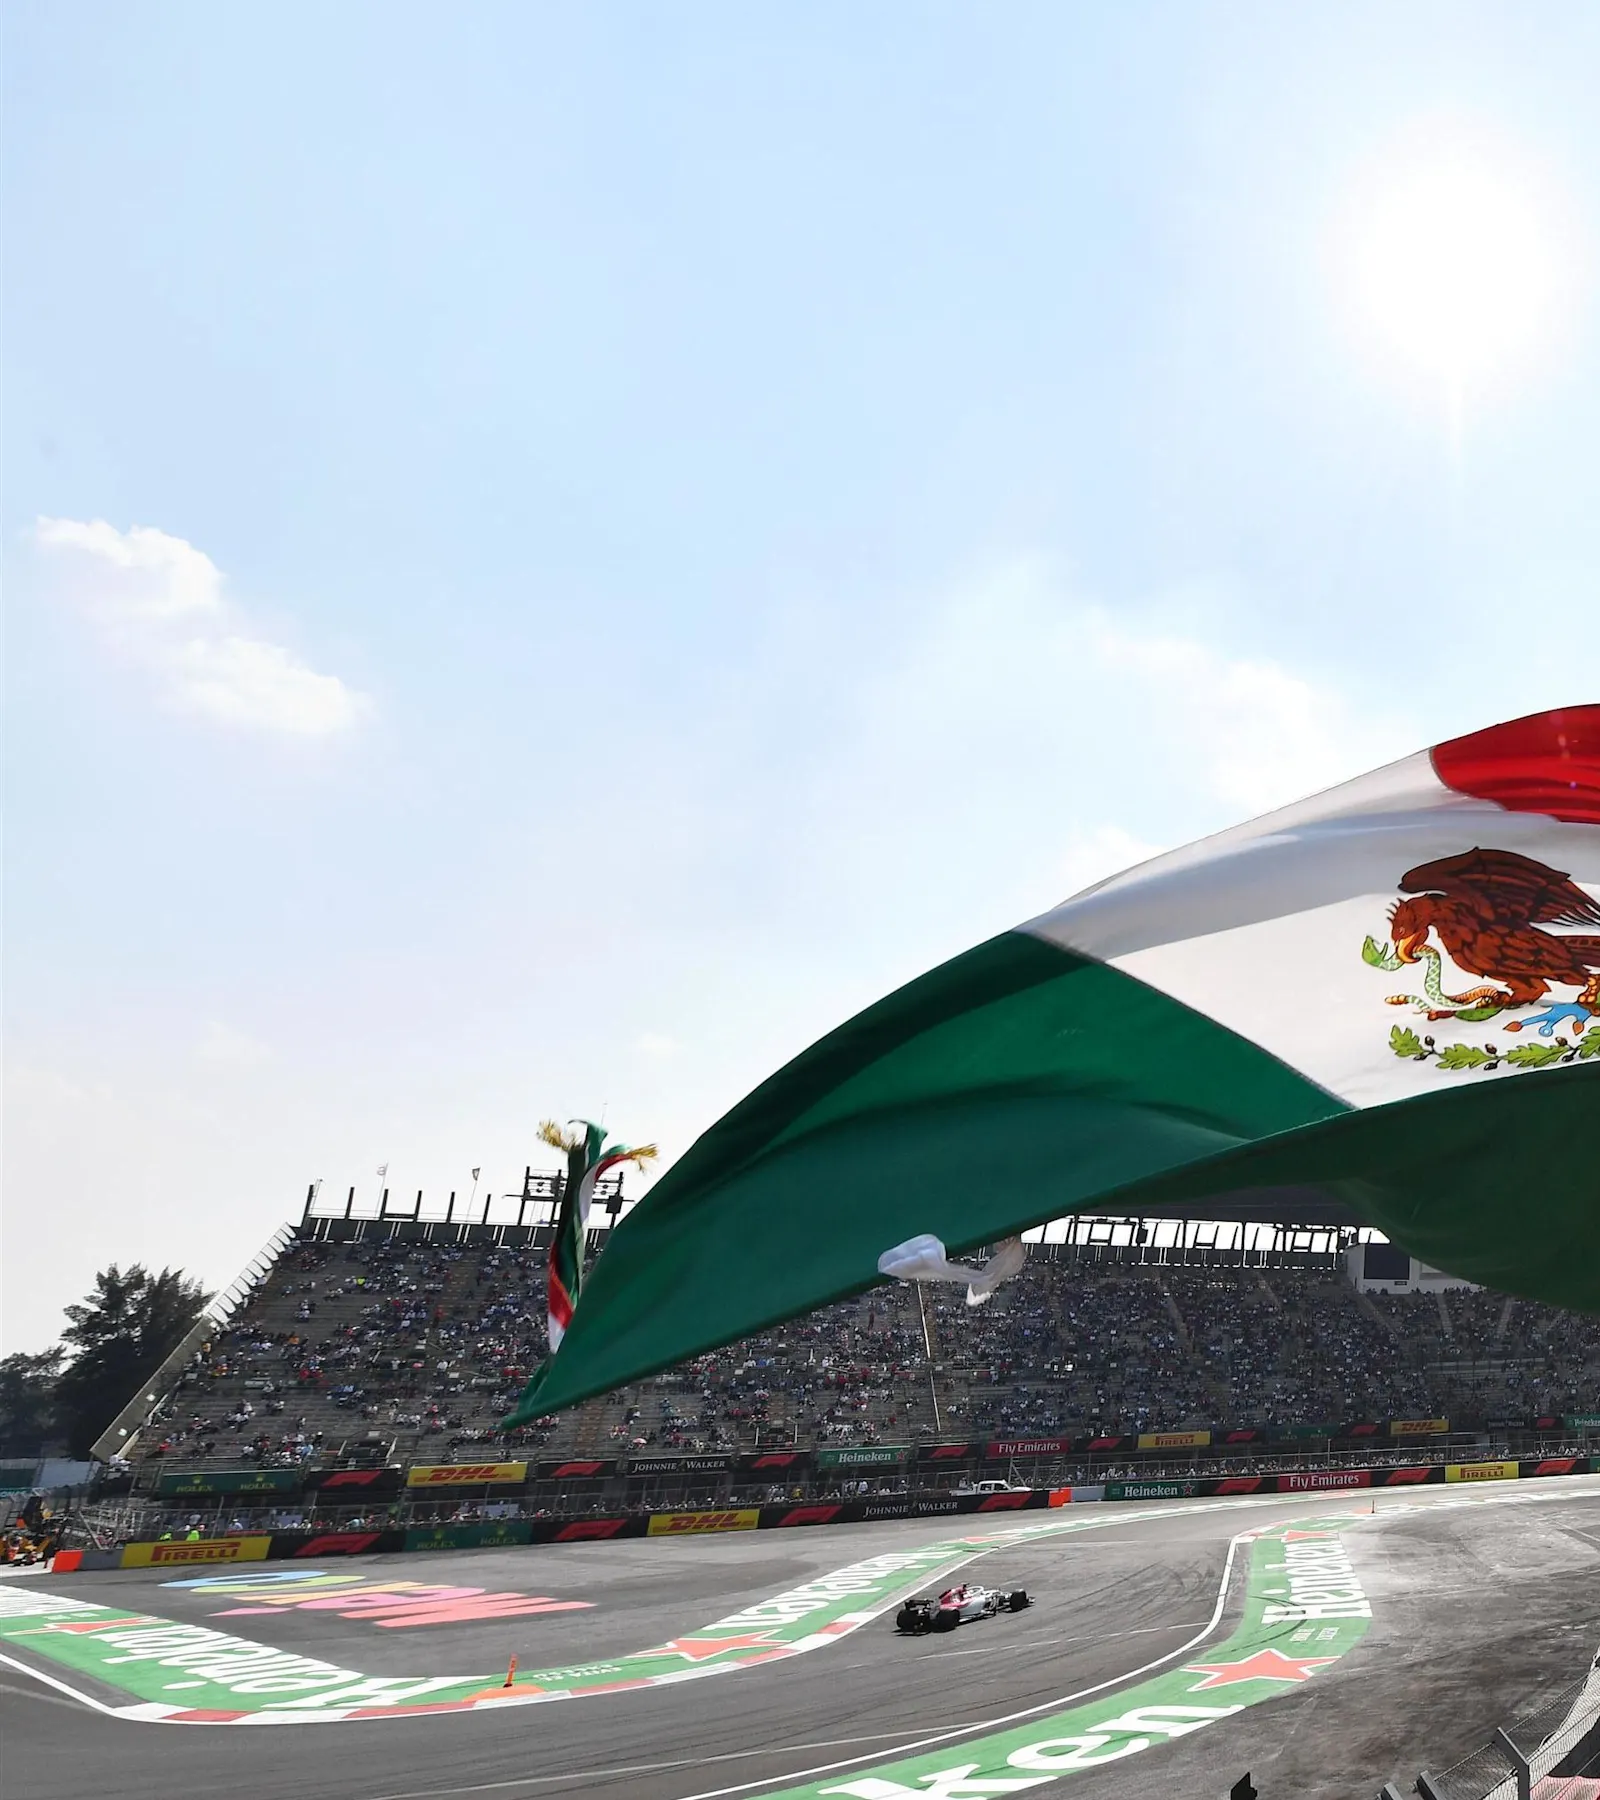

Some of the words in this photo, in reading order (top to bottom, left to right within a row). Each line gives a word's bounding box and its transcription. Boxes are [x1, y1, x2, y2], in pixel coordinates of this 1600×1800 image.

[998, 1442, 1016, 1454] Fly
[1018, 1440, 1061, 1452] Emirates
[1154, 1435, 1195, 1447] PIRELLI
[838, 1451, 891, 1463] Heineken
[632, 1461, 677, 1473] JOHNNIE
[686, 1459, 726, 1469] WALKER
[1460, 1465, 1504, 1479] PIRELLI
[429, 1465, 502, 1482] DHL
[176, 1483, 214, 1493] ROLEX
[240, 1482, 277, 1491] ROLEX
[1289, 1475, 1309, 1490] Fly
[1311, 1473, 1360, 1486] Emirates
[1123, 1485, 1178, 1498] Heineken
[862, 1504, 909, 1519] JOHNNIE
[918, 1501, 958, 1512] WALKER
[666, 1512, 741, 1531] DHL
[416, 1539, 456, 1549] ROLEX
[479, 1535, 519, 1545] ROLEX
[150, 1541, 242, 1562] PIRELLI
[1262, 1540, 1373, 1624] Heineken
[90, 1624, 491, 1707] Heineken
